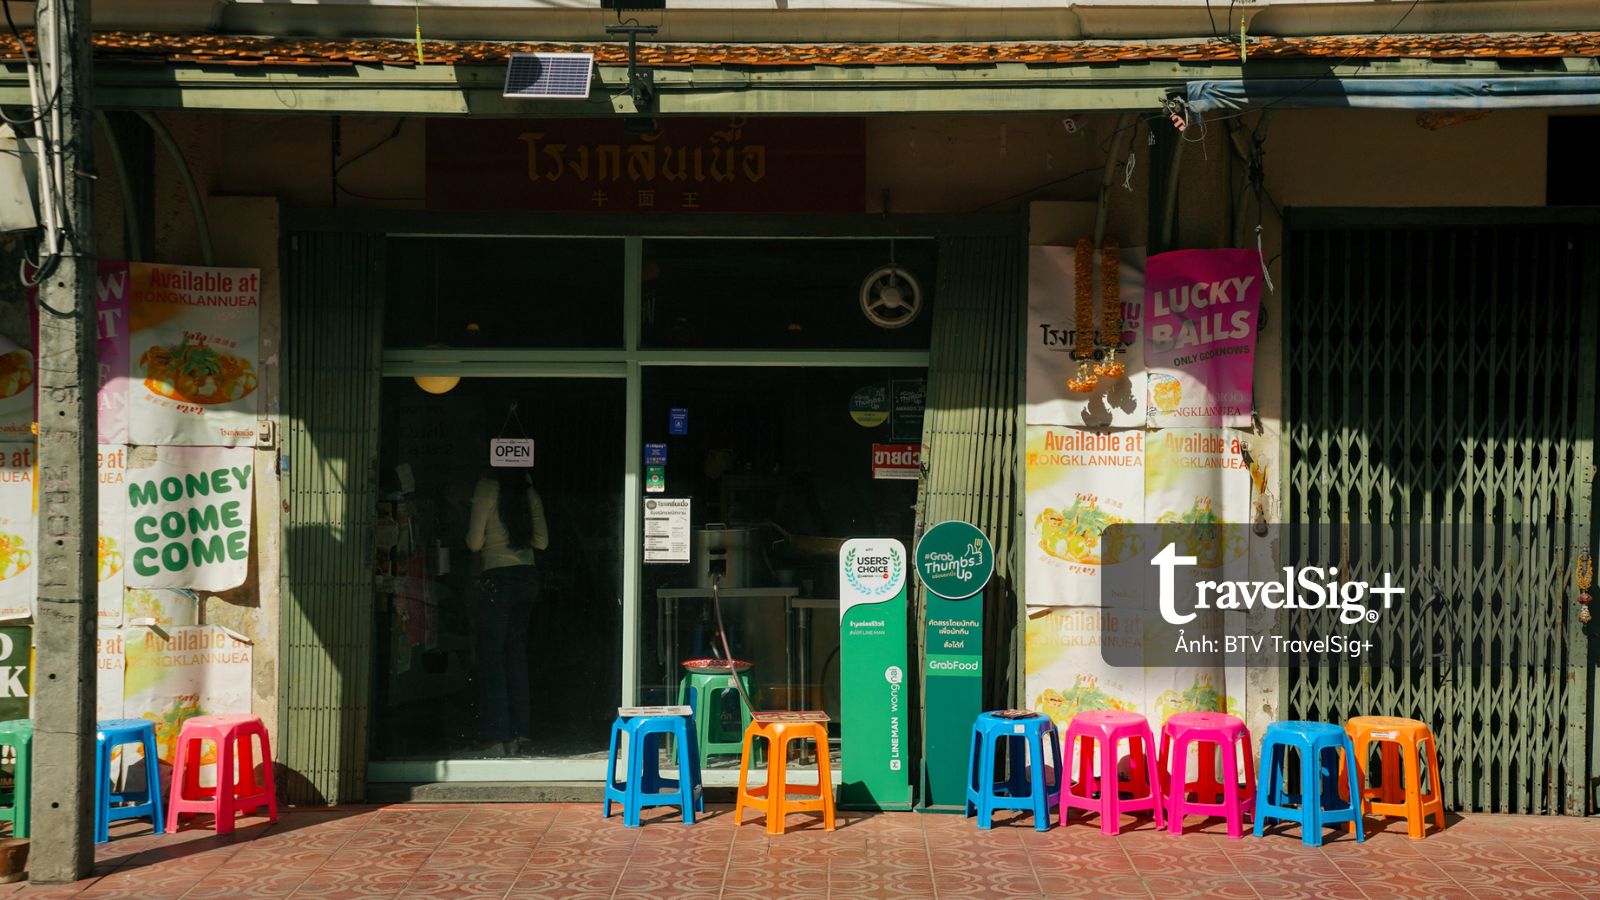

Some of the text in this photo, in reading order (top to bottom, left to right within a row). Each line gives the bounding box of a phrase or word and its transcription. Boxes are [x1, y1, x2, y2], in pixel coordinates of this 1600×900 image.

[151, 268, 232, 293] Available
[239, 273, 258, 292] at
[135, 290, 257, 307] RONGKLANNUEA
[1153, 275, 1254, 317] LUCKY
[1152, 310, 1251, 353] BALLS
[1173, 352, 1198, 367] ONLY
[1174, 405, 1242, 417] NGKLANNUEA
[495, 445, 530, 457] OPEN
[1044, 431, 1143, 453] Available at
[1165, 432, 1240, 454] Available a
[1030, 454, 1142, 467] RONGKLANNUEA
[129, 464, 252, 508] MONEY
[134, 500, 244, 543] COME
[133, 530, 248, 577] COME
[924, 551, 954, 561] #Grab
[925, 556, 975, 574] Thumbs
[956, 566, 972, 582] Up
[929, 661, 979, 671] GrabFood
[891, 717, 899, 758] LINEMAN
